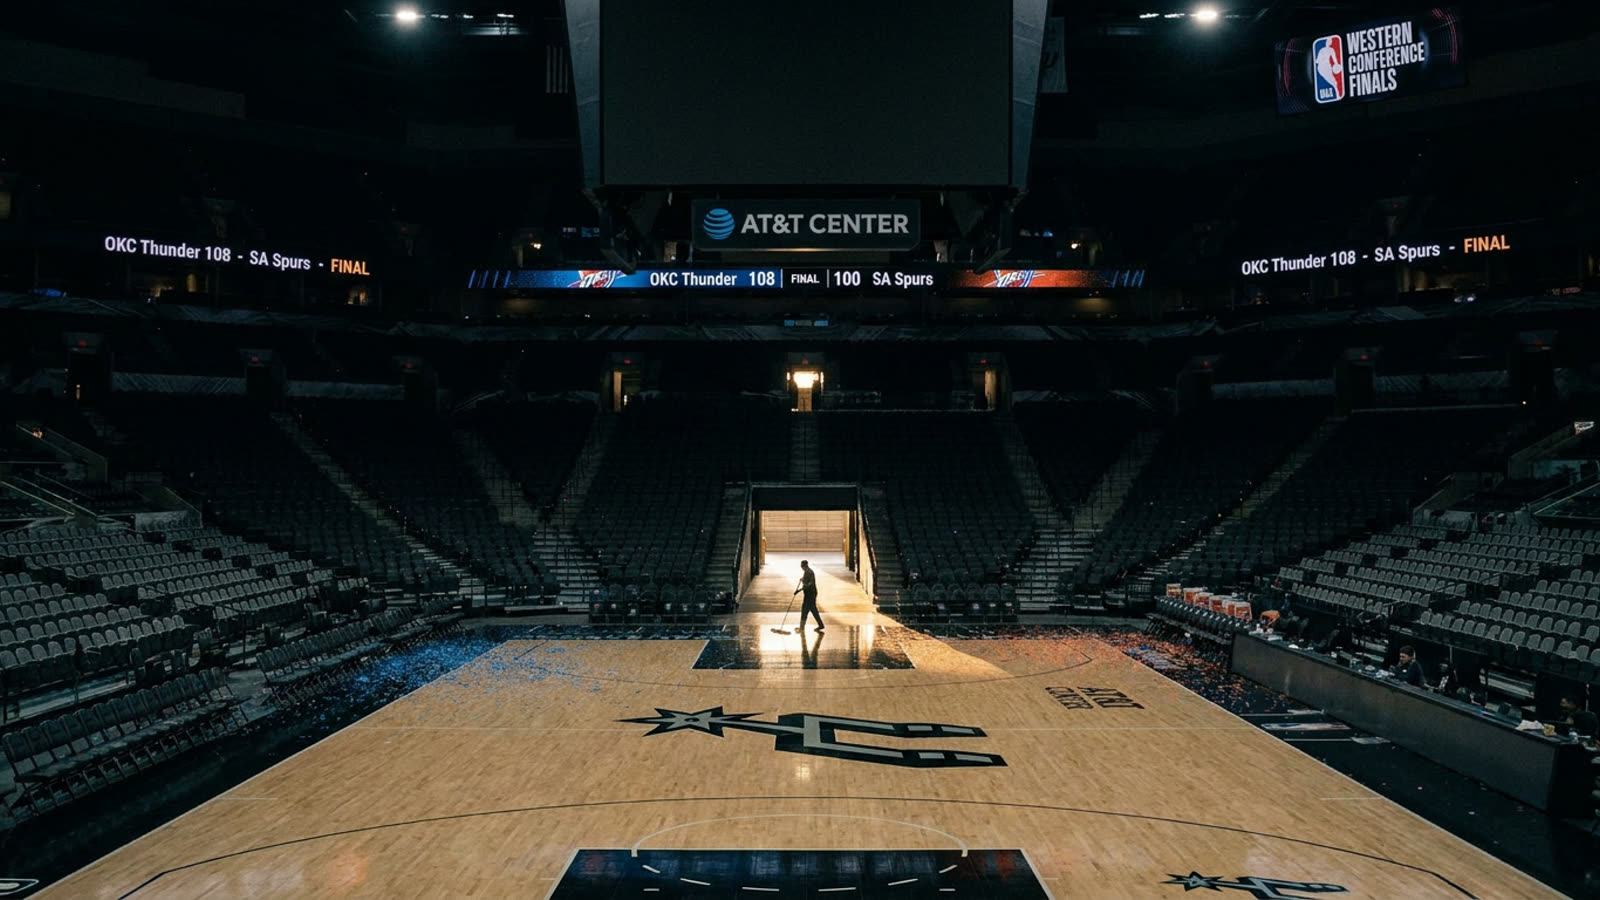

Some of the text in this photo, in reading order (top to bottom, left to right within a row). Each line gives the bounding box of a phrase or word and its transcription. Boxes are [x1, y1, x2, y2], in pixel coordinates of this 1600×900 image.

[1346, 21, 1413, 55] WESTERN
[1348, 42, 1425, 75] CONFERENCE
[1349, 68, 1398, 98] FINALS
[741, 214, 909, 234] AT&T CENTER
[104, 235, 137, 253] OKC
[139, 239, 201, 259] Thunder
[204, 246, 232, 263] 108
[249, 249, 269, 266] SA
[272, 252, 311, 272] Spurs
[330, 258, 370, 276] FINAL
[1241, 258, 1269, 276] OKC
[1271, 253, 1327, 273] Thunder
[1330, 249, 1356, 267] 108
[1374, 246, 1395, 263] SA
[1398, 242, 1441, 263] Spurs
[1463, 234, 1511, 254] FINAL
[649, 271, 934, 289] OKC Thunder 108 FINAL 100 SA Spurs
